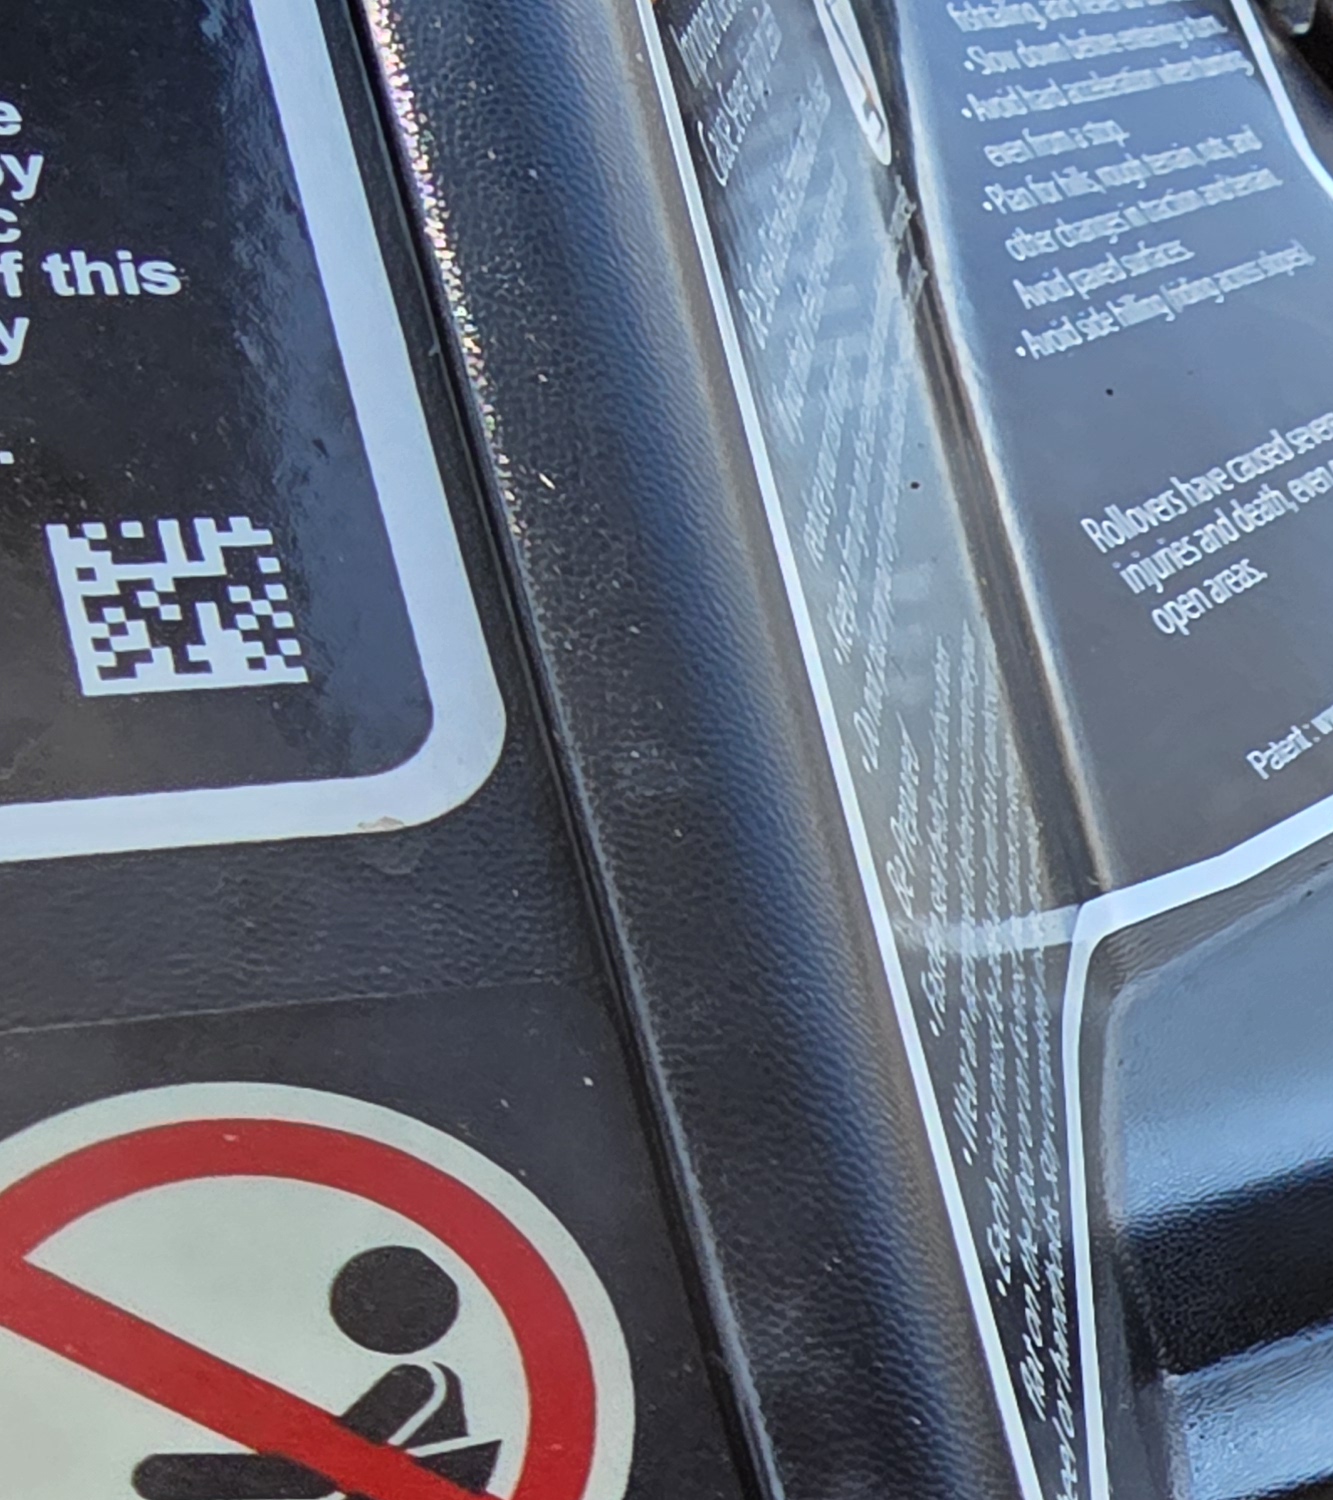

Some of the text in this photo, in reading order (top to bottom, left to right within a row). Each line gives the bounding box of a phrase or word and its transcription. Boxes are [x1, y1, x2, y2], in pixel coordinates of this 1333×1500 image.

[966, 45, 1020, 75] Slow
[1016, 39, 1070, 68] down
[1059, 29, 1123, 60] before
[966, 86, 1028, 122] Avoid
[1015, 78, 1069, 111] hard
[983, 139, 1032, 167] even
[1022, 128, 1076, 157] from
[1069, 128, 1089, 149] a
[984, 183, 1037, 214] Plan
[1025, 174, 1063, 205] for
[1052, 166, 1106, 197] hills,
[1095, 154, 1150, 192] rough
[1005, 227, 1059, 261] other
[1055, 211, 1130, 248] changes
[1117, 202, 1147, 228] in
[41, 250, 182, 296] this
[1013, 240, 1195, 309] Avoid paved surfaces.
[1021, 315, 1083, 360] Avoid
[1076, 306, 1120, 341] side
[1106, 294, 1176, 328] hilling
[1081, 490, 1187, 552] Rollovers
[1170, 467, 1234, 507] have
[1226, 429, 1294, 483] caused
[1114, 536, 1202, 594] injuries
[1193, 508, 1240, 554] and
[1231, 484, 1299, 533] death,
[1152, 558, 1268, 635] open areas.
[1247, 726, 1312, 779] Patent
